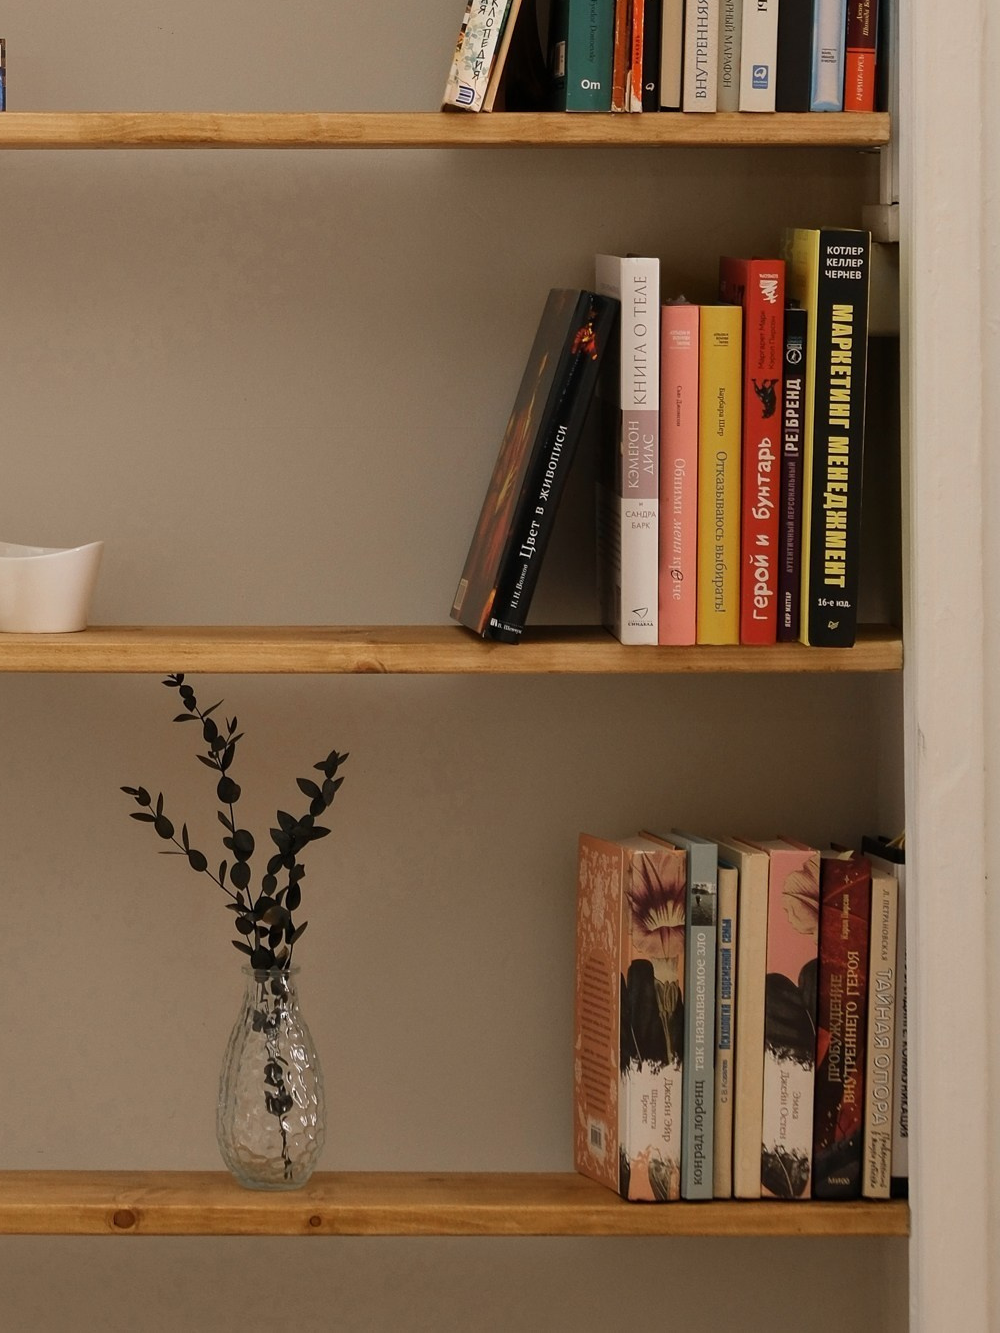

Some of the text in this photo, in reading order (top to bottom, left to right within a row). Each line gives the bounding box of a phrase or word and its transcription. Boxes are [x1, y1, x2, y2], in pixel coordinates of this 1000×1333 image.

[824, 270, 861, 280] ЧЕРНЕВ
[826, 246, 864, 255] КОТЛЕР
[826, 258, 864, 268] КЕЛЛЕР
[633, 276, 647, 404] КНИГА О ТЕЛЕ
[627, 421, 641, 489] КЭМЕРОН
[643, 434, 655, 474] ДИАС
[822, 304, 853, 588] МАРКЕТИНГ МЕНЕДЖМЕНТ
[520, 520, 540, 558] Цвет
[535, 507, 544, 515] в
[712, 451, 728, 613] Отказываюсь выбирать!
[694, 933, 707, 1071] так называемое зло
[828, 974, 842, 1082] ПРОБУЖДЕНИЕ
[844, 952, 859, 1104] ВНУТРЕННЕГО ГЕРОЯ
[872, 968, 893, 1126] ТАЙНАЯ ОПОРА
[692, 1081, 706, 1186] конрад лоренц
